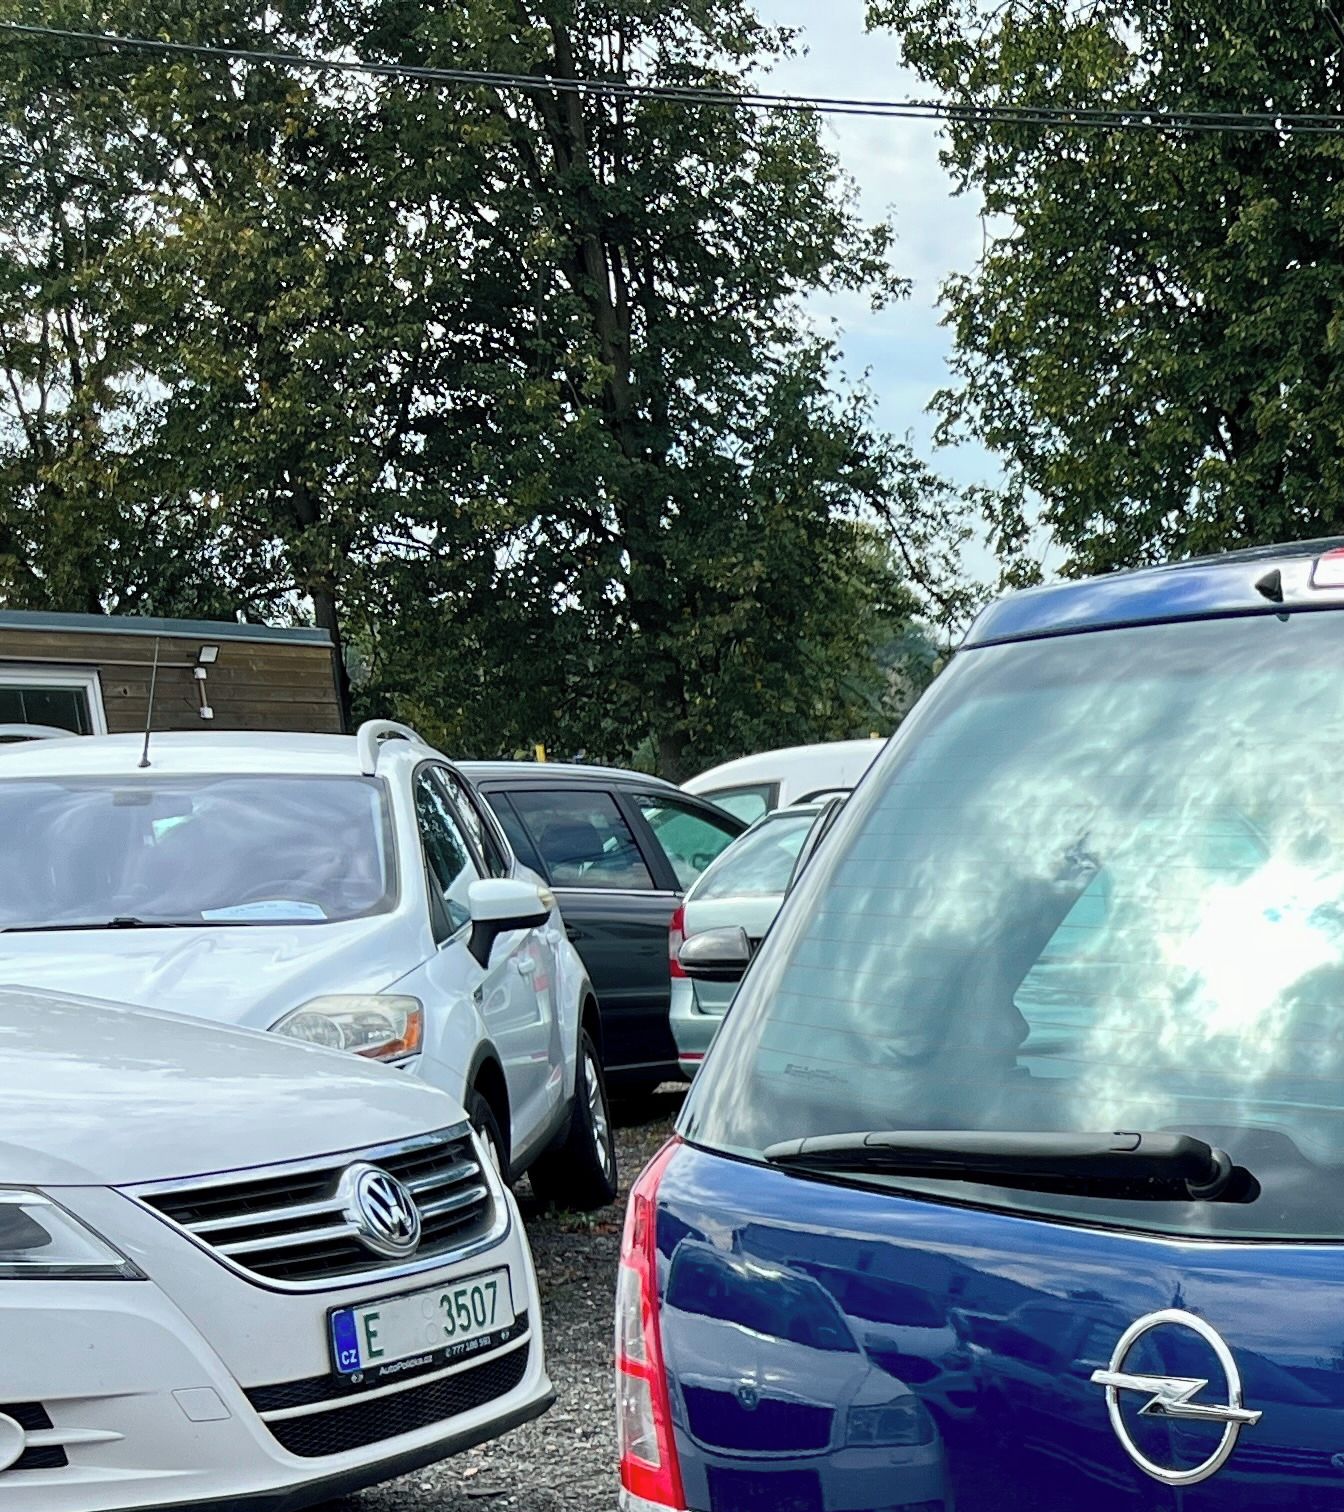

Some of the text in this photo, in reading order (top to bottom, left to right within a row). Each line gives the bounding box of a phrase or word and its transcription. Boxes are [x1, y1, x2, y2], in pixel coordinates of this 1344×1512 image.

[363, 1280, 498, 1359] E 3507
[341, 1350, 358, 1365] CZ
